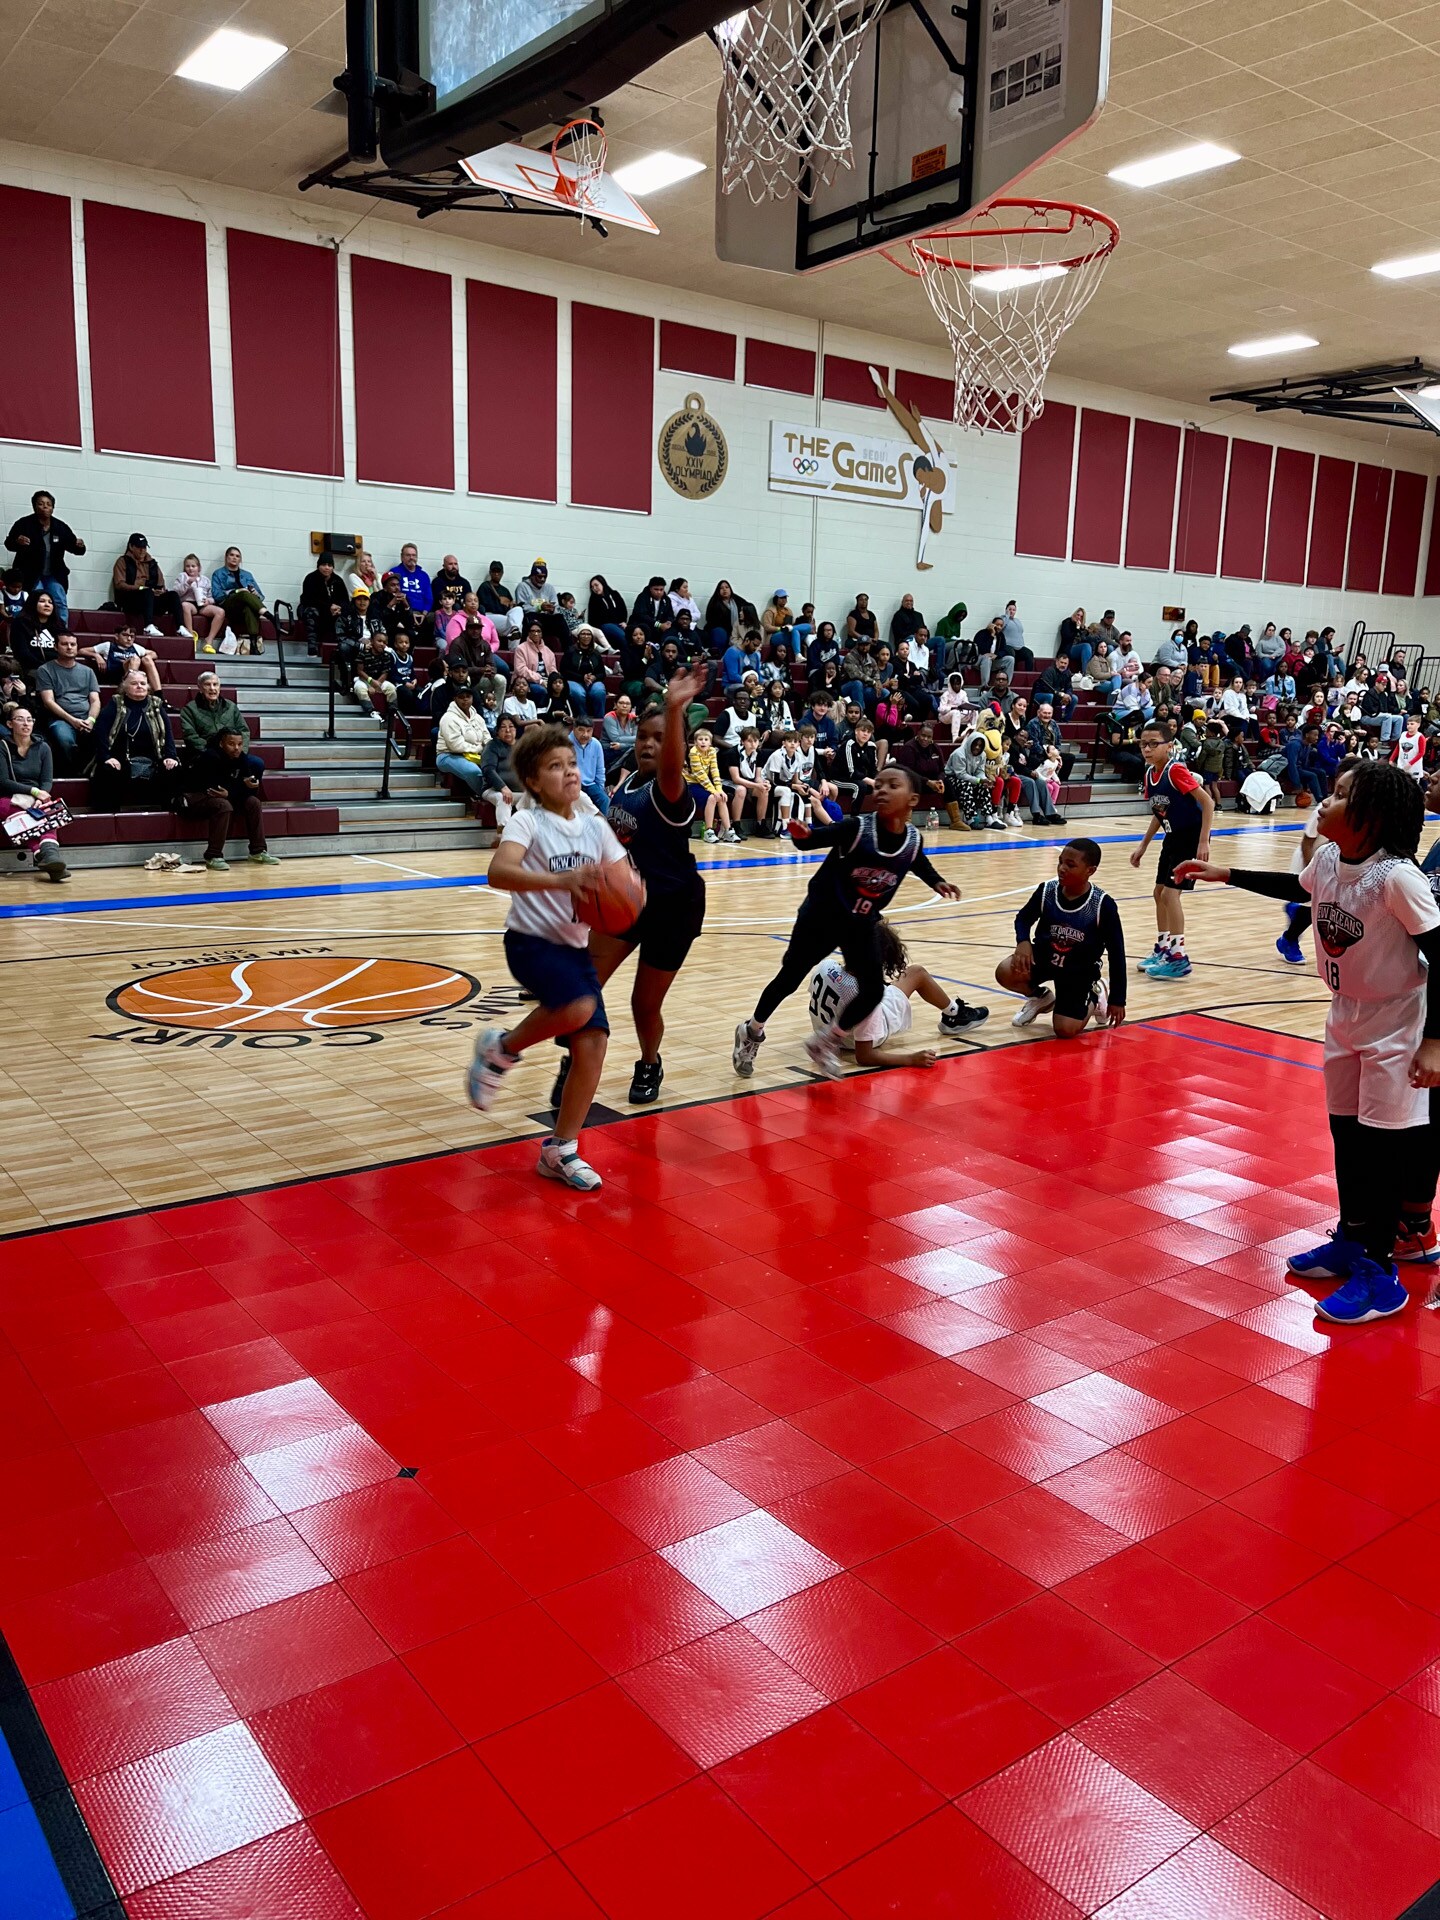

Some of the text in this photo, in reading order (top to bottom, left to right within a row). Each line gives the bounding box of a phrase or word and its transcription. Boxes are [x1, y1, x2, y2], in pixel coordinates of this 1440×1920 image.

[783, 432, 831, 458] THE
[685, 456, 704, 468] XXIV
[675, 465, 713, 481] OLYMPIAD
[551, 856, 571, 870] NEW
[852, 898, 873, 914] 19
[1058, 926, 1085, 942] ORLEANS
[130, 946, 333, 970] KIM PERROT
[201, 949, 248, 957] 2019
[1050, 952, 1066, 968] 21
[1325, 959, 1340, 991] 18
[809, 972, 841, 1025] 35
[88, 1026, 385, 1049] COURT
